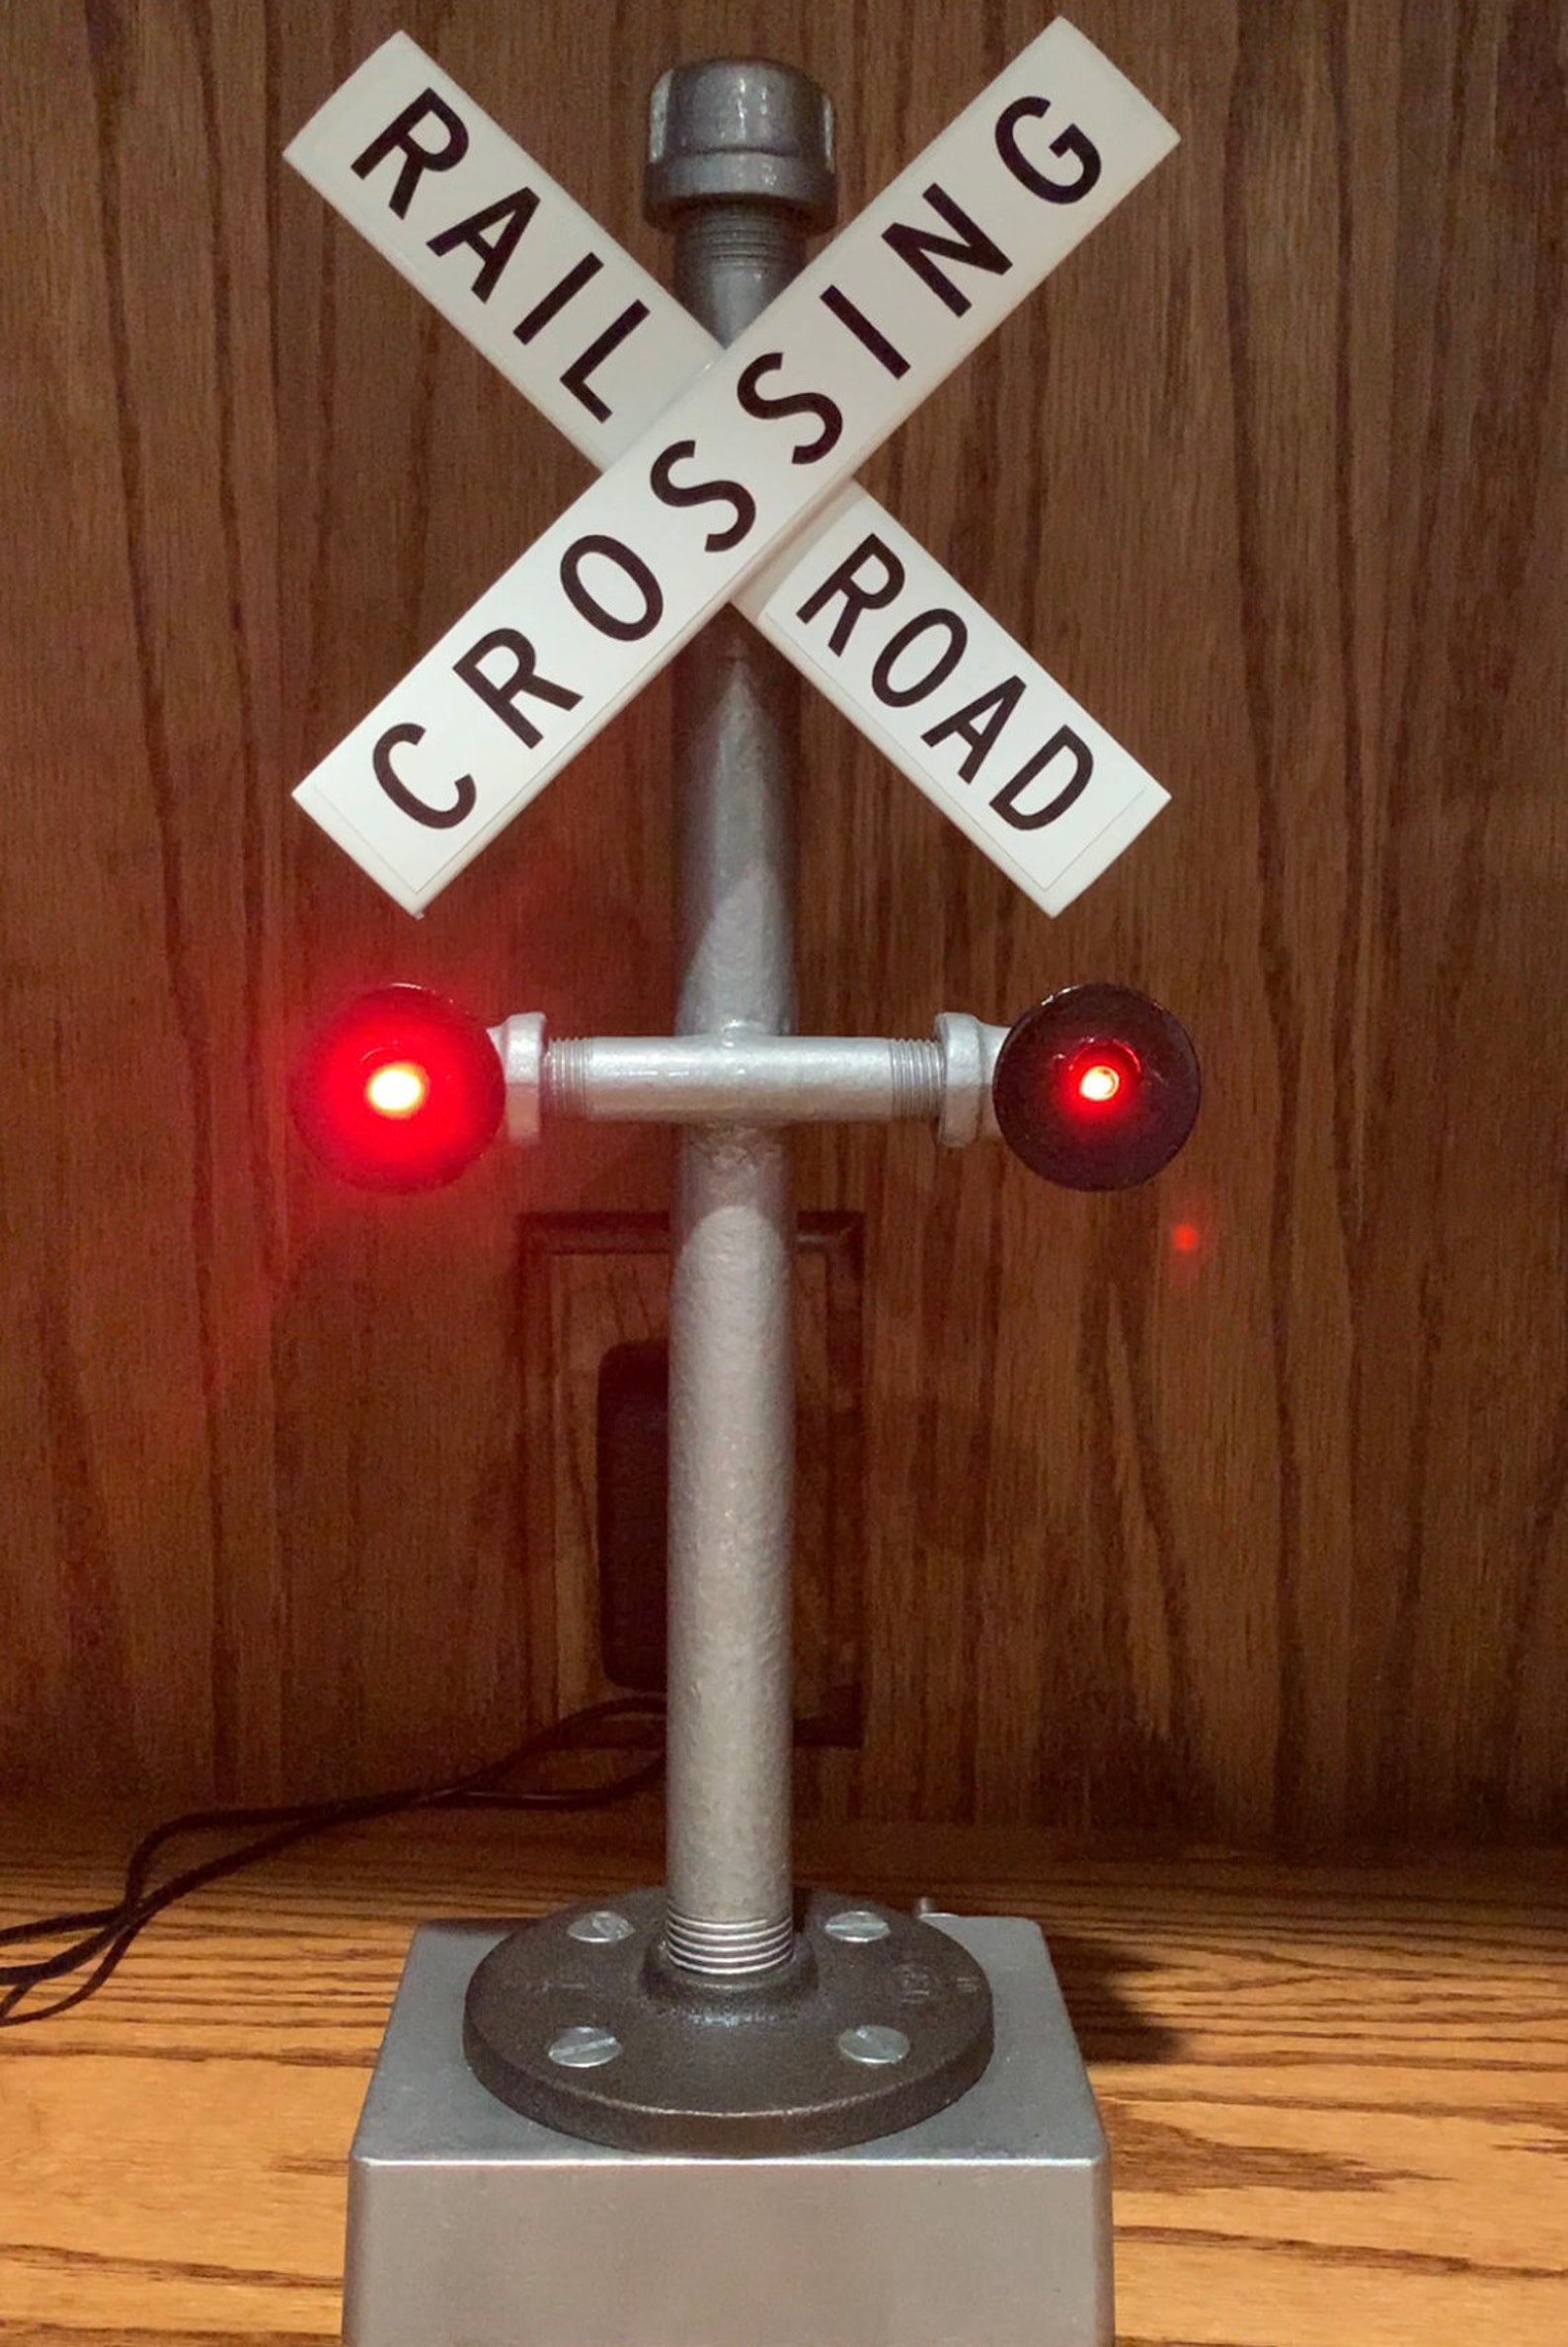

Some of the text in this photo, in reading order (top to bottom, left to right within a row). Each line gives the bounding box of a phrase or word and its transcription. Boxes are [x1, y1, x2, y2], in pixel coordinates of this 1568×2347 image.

[351, 88, 1094, 831] RAIL ROAD
[371, 96, 1103, 830] CROSSING
